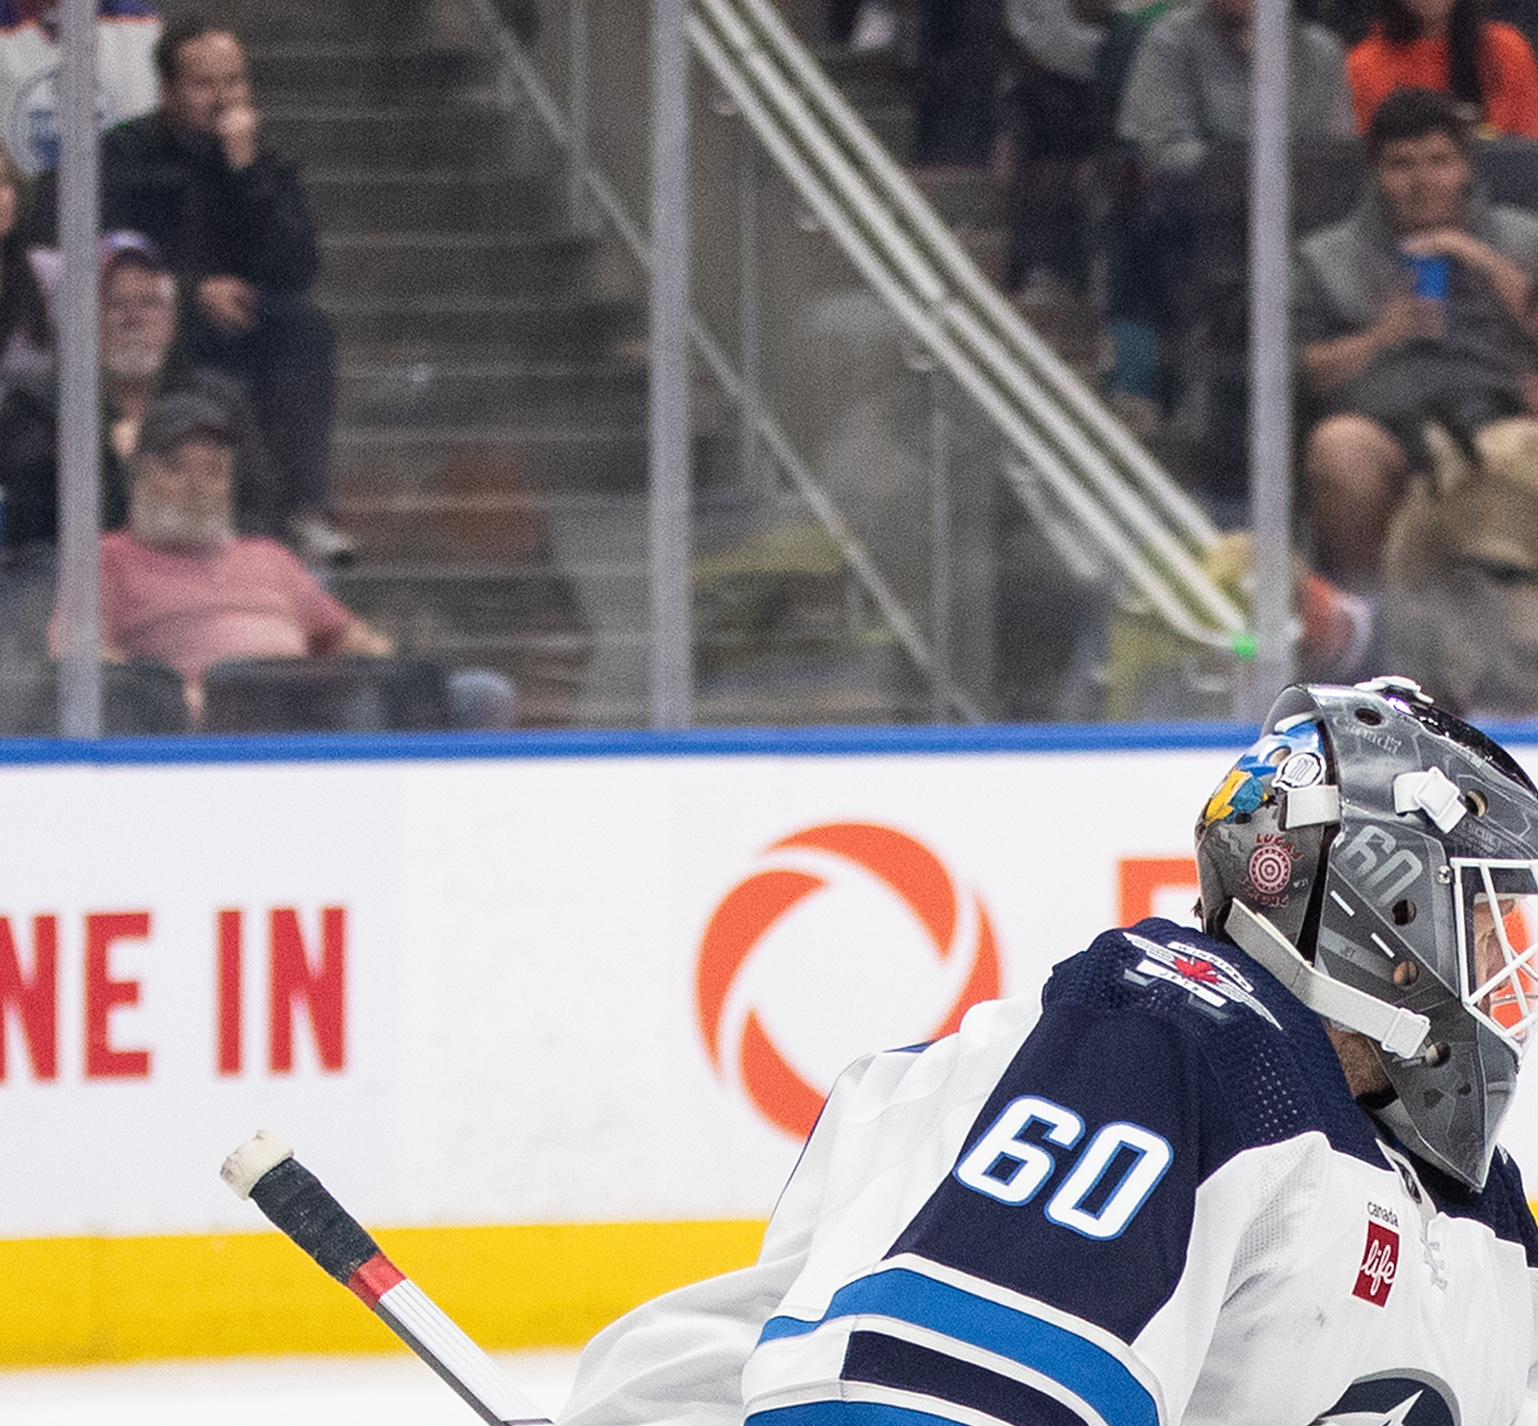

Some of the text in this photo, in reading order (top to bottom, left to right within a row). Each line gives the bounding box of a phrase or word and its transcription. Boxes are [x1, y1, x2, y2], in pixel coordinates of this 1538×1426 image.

[1255, 832, 1303, 861] LUCAS
[1336, 823, 1424, 912] 60
[216, 905, 350, 1077] IN
[952, 1094, 1176, 1242] 60
[1366, 1200, 1400, 1228] canada
[1360, 1239, 1395, 1296] life
